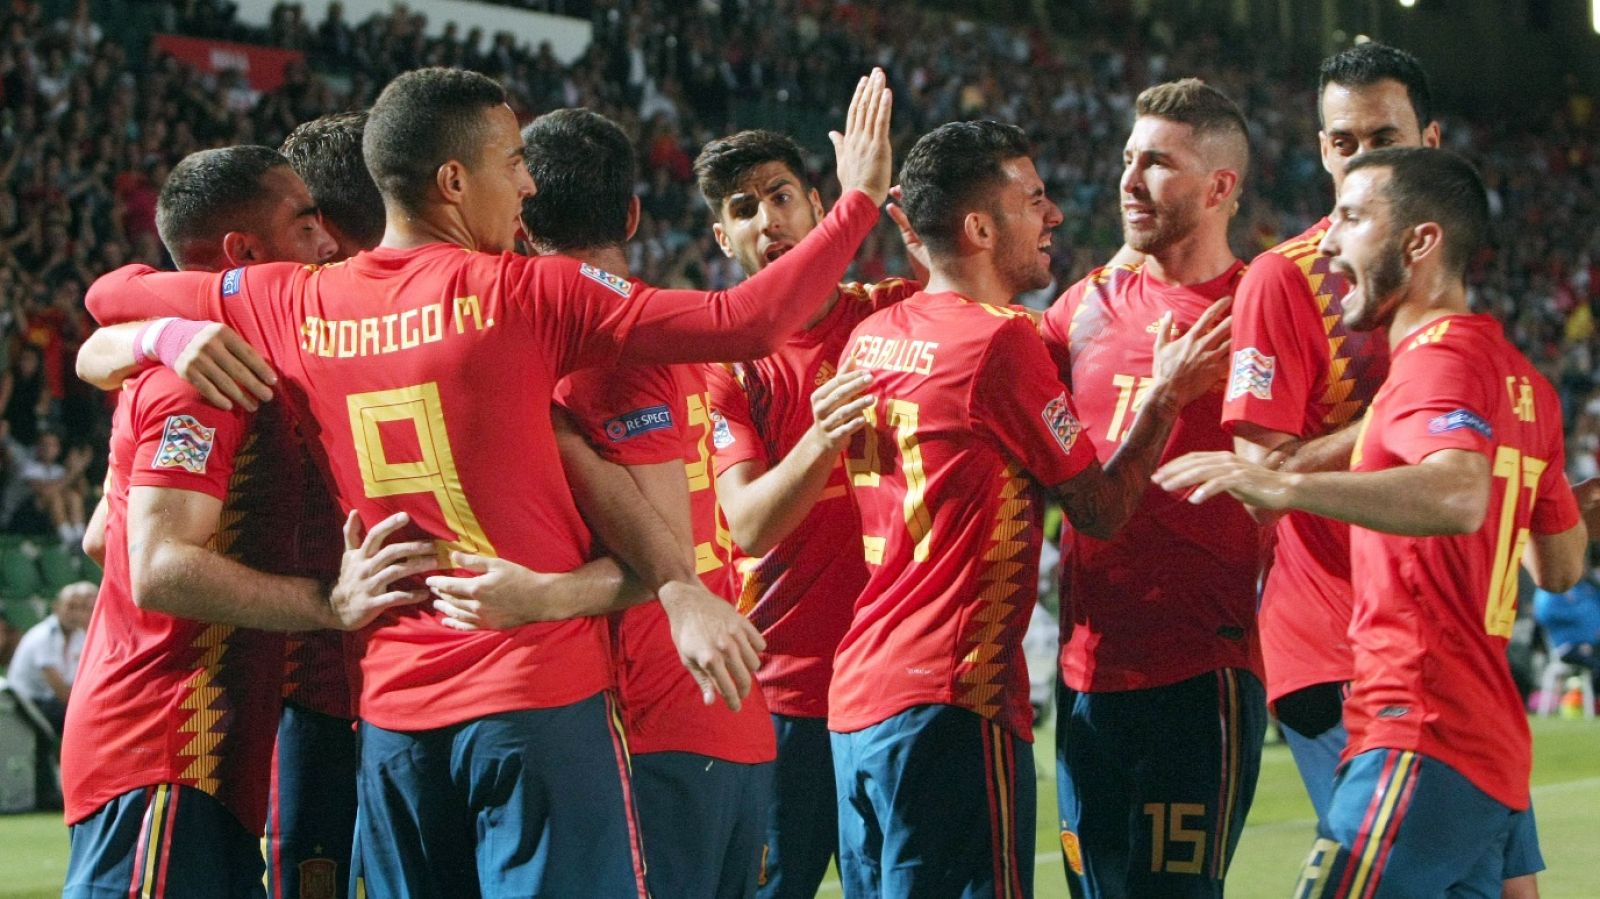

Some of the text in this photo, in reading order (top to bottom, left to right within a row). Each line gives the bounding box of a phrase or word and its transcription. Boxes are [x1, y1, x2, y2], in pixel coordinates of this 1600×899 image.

[301, 295, 495, 358] RODRIGO M.
[626, 411, 670, 430] RESPECT
[346, 382, 498, 569] 9
[1143, 802, 1207, 874] 15
